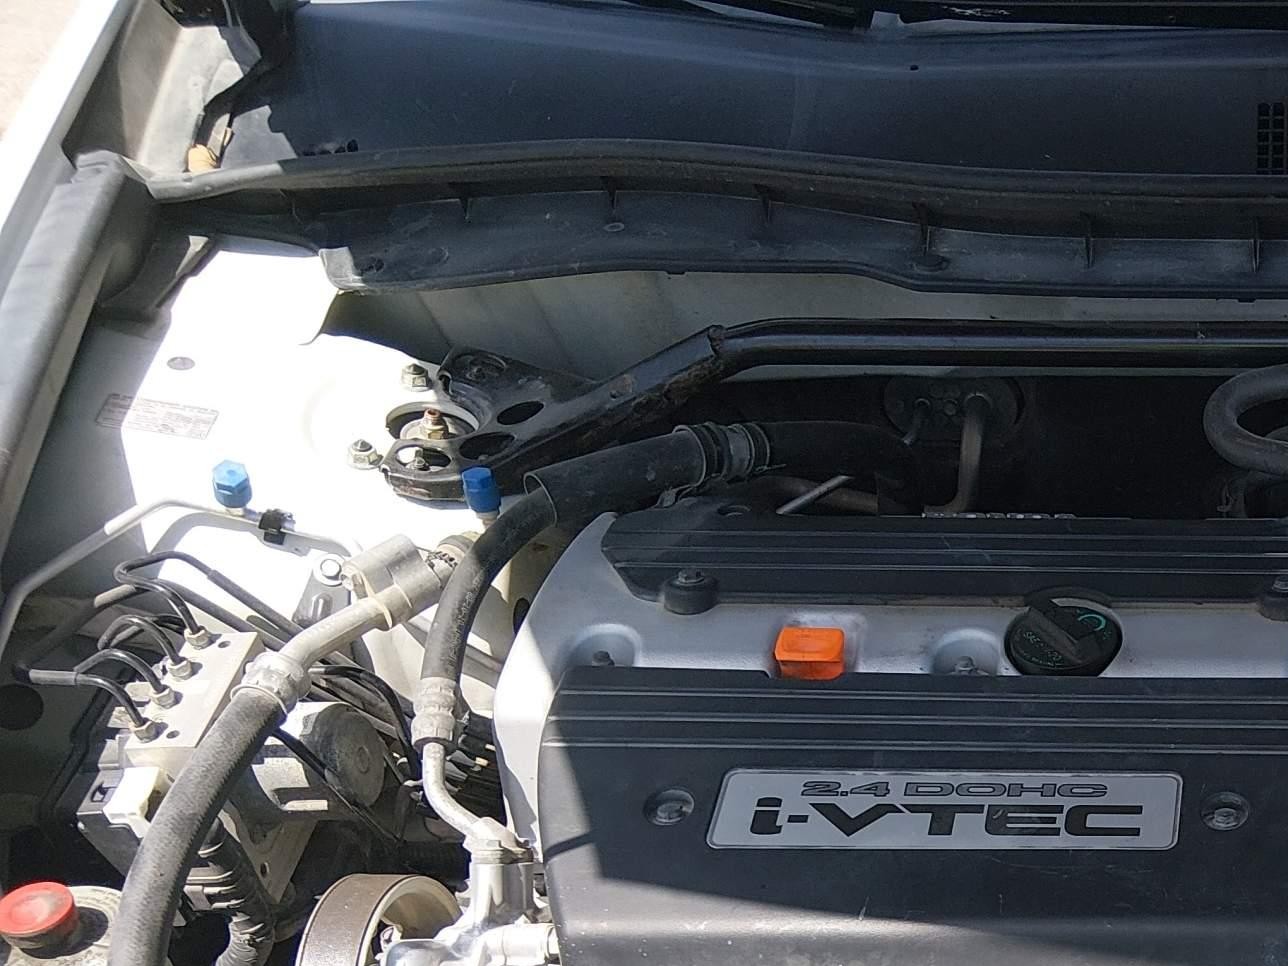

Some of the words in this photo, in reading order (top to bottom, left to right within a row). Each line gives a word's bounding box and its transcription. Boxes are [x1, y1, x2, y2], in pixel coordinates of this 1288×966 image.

[800, 781, 890, 797] 2.4
[903, 781, 1108, 798] DOHC
[749, 797, 1143, 837] i-VTEC
